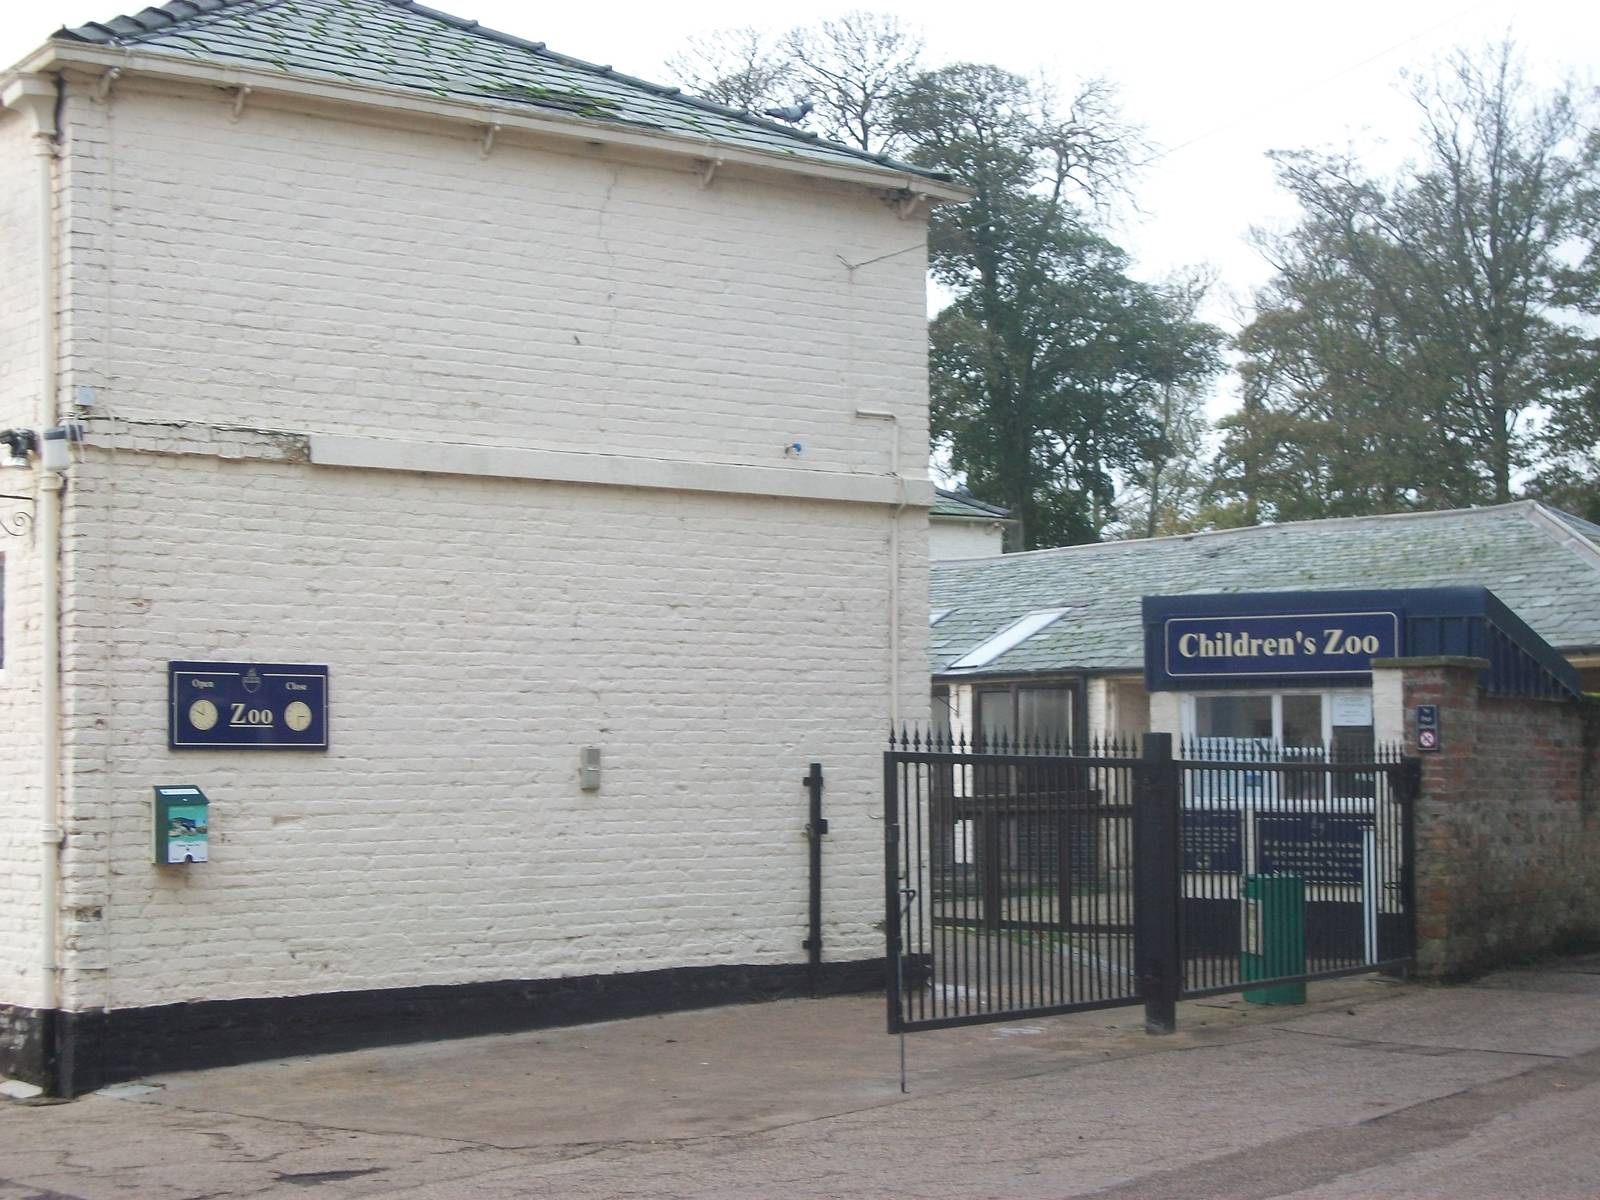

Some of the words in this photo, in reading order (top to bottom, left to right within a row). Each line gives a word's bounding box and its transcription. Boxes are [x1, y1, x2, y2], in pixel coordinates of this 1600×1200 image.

[1178, 631, 1316, 658] Children's
[1323, 629, 1380, 655] Zoo
[191, 678, 215, 689] Open
[230, 703, 274, 725] Zoo
